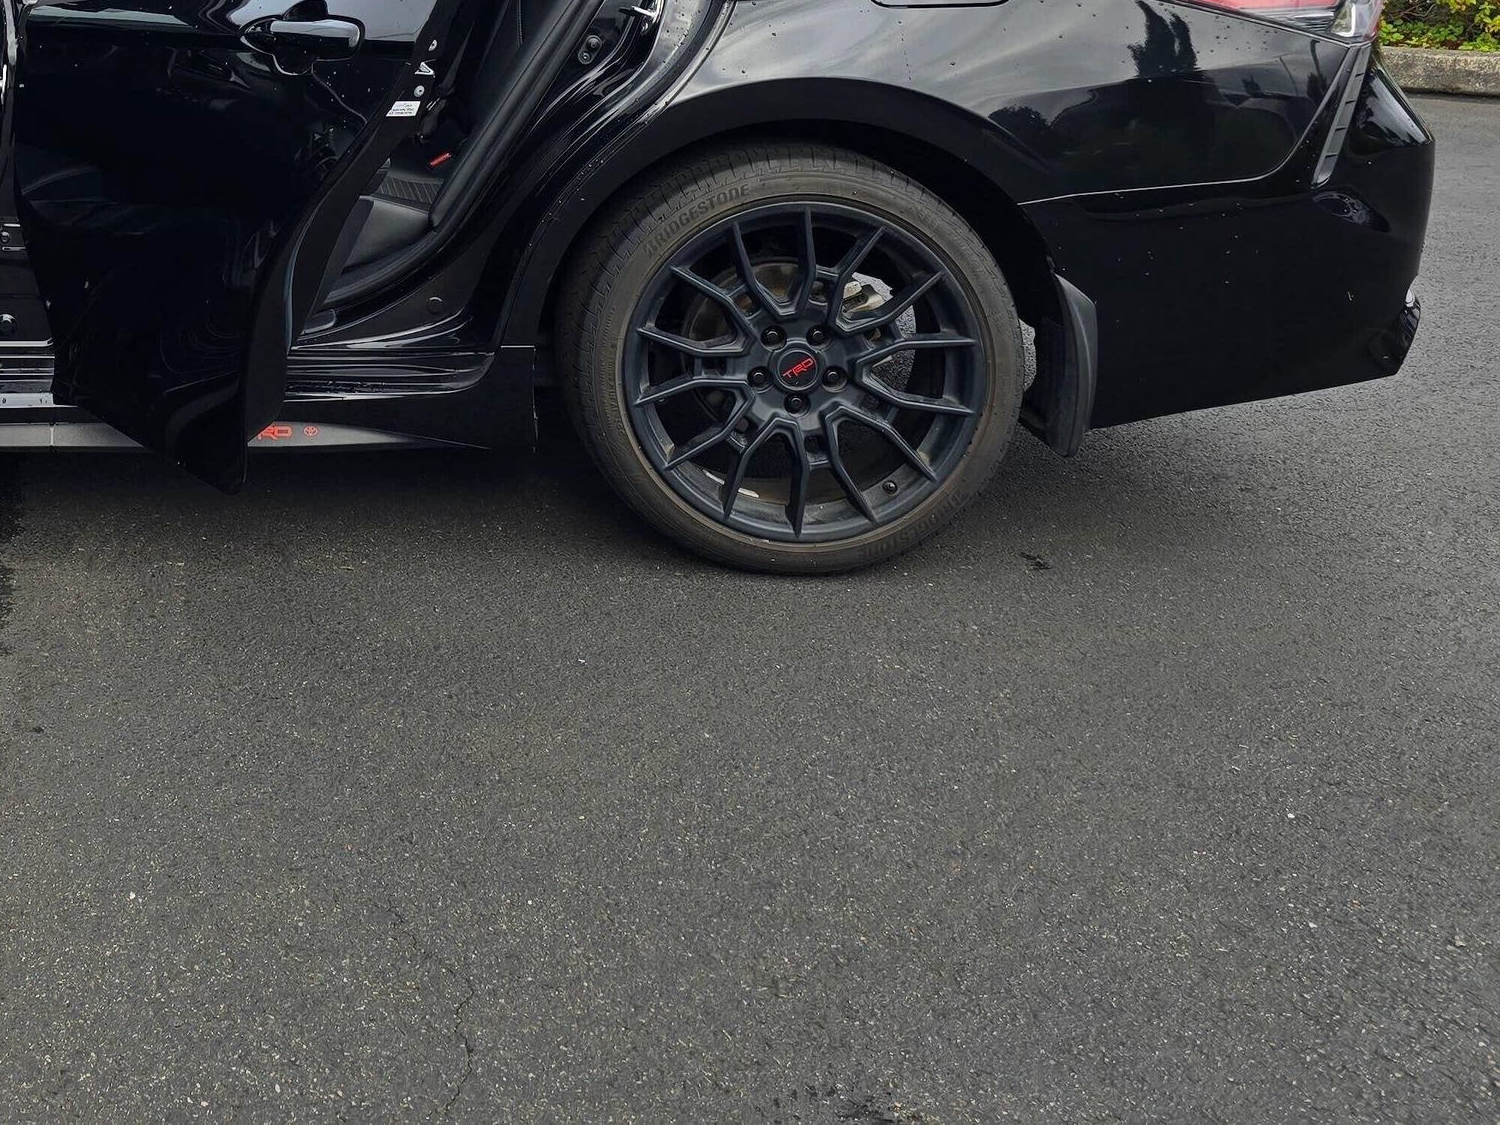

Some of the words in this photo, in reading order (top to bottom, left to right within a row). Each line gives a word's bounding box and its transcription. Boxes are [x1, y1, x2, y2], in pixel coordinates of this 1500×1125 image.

[643, 183, 750, 259] BRIDGESTONE
[782, 357, 814, 379] TRD
[257, 425, 293, 440] RD
